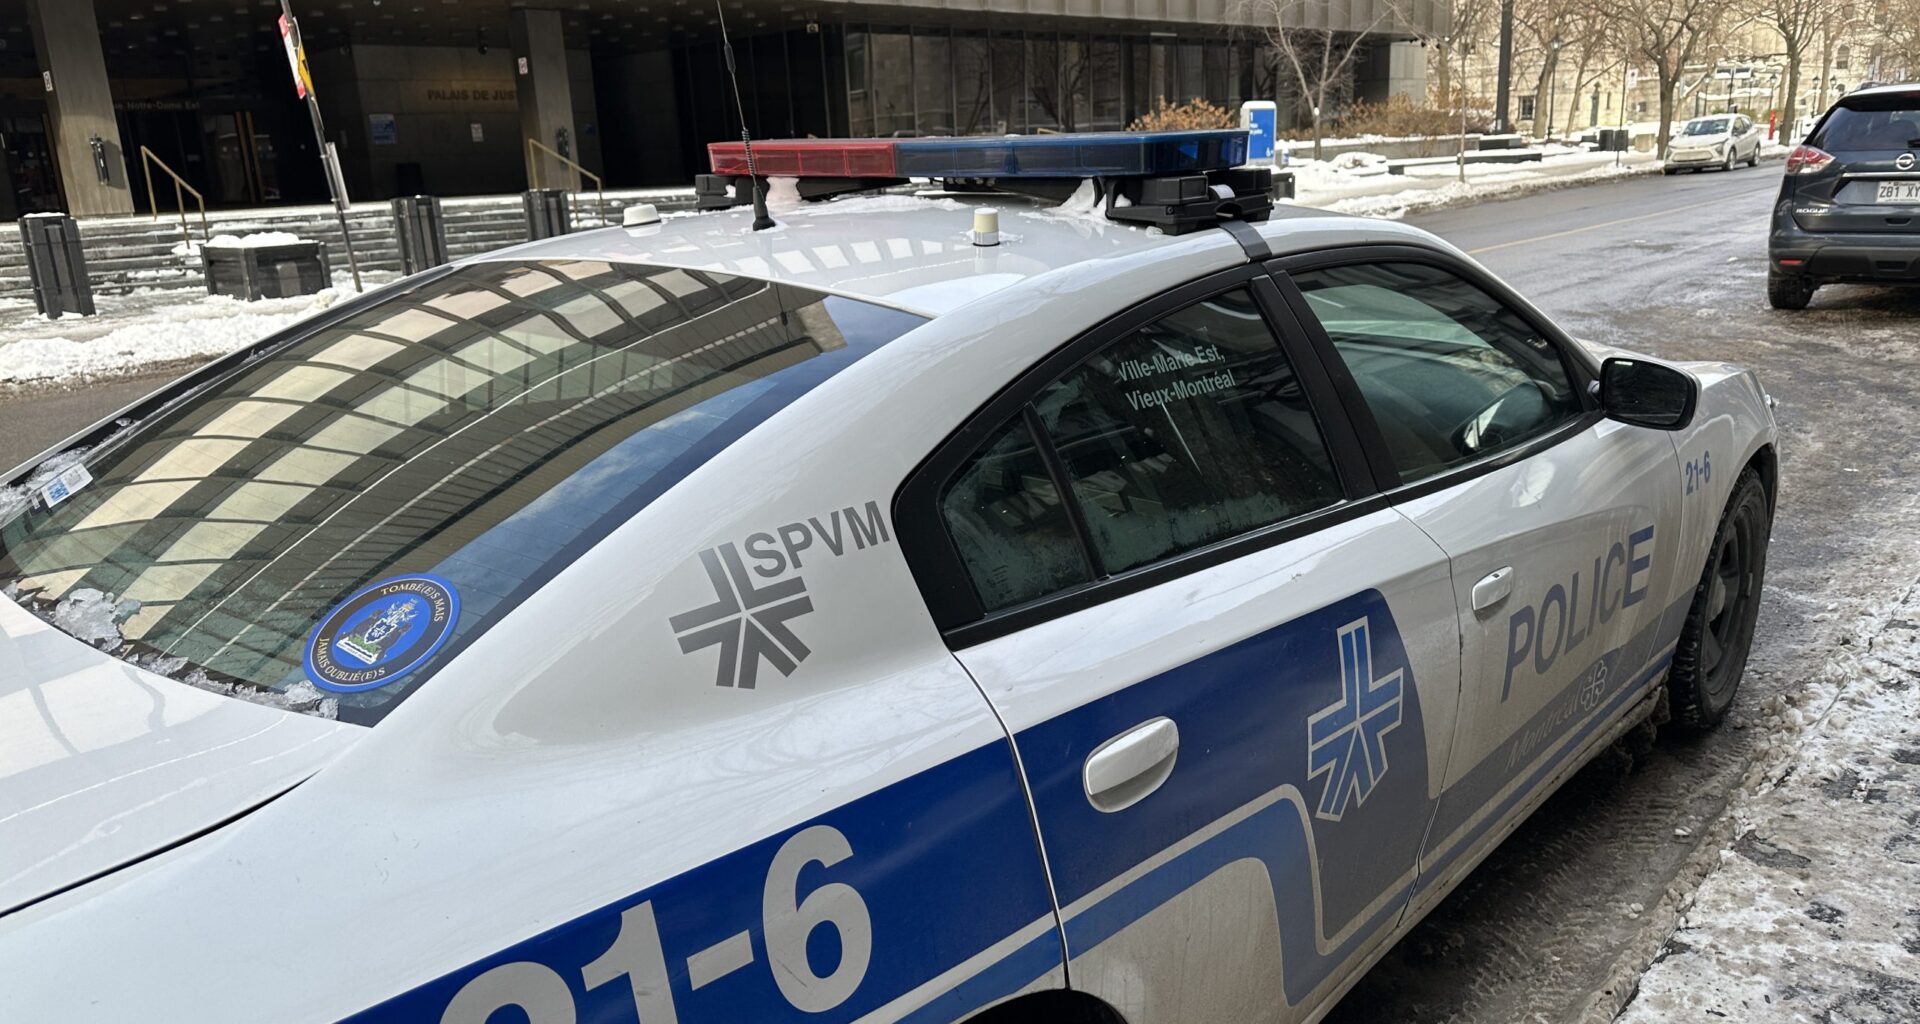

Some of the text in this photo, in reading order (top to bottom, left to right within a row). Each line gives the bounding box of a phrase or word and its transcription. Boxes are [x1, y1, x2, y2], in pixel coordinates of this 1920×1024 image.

[427, 89, 517, 101] PALAIS DE JUS
[1118, 344, 1226, 382] Ville-Marie Est,
[1125, 369, 1237, 411] Vieux-Montréal
[1685, 450, 1711, 495] 21-6
[744, 500, 890, 578] SPVM
[380, 582, 446, 622] TOMBÉ(E)S MAIS
[1501, 525, 1654, 703] POLICE
[317, 637, 330, 669] JAMAIS
[324, 663, 386, 682] OUBLIÉ(E)S
